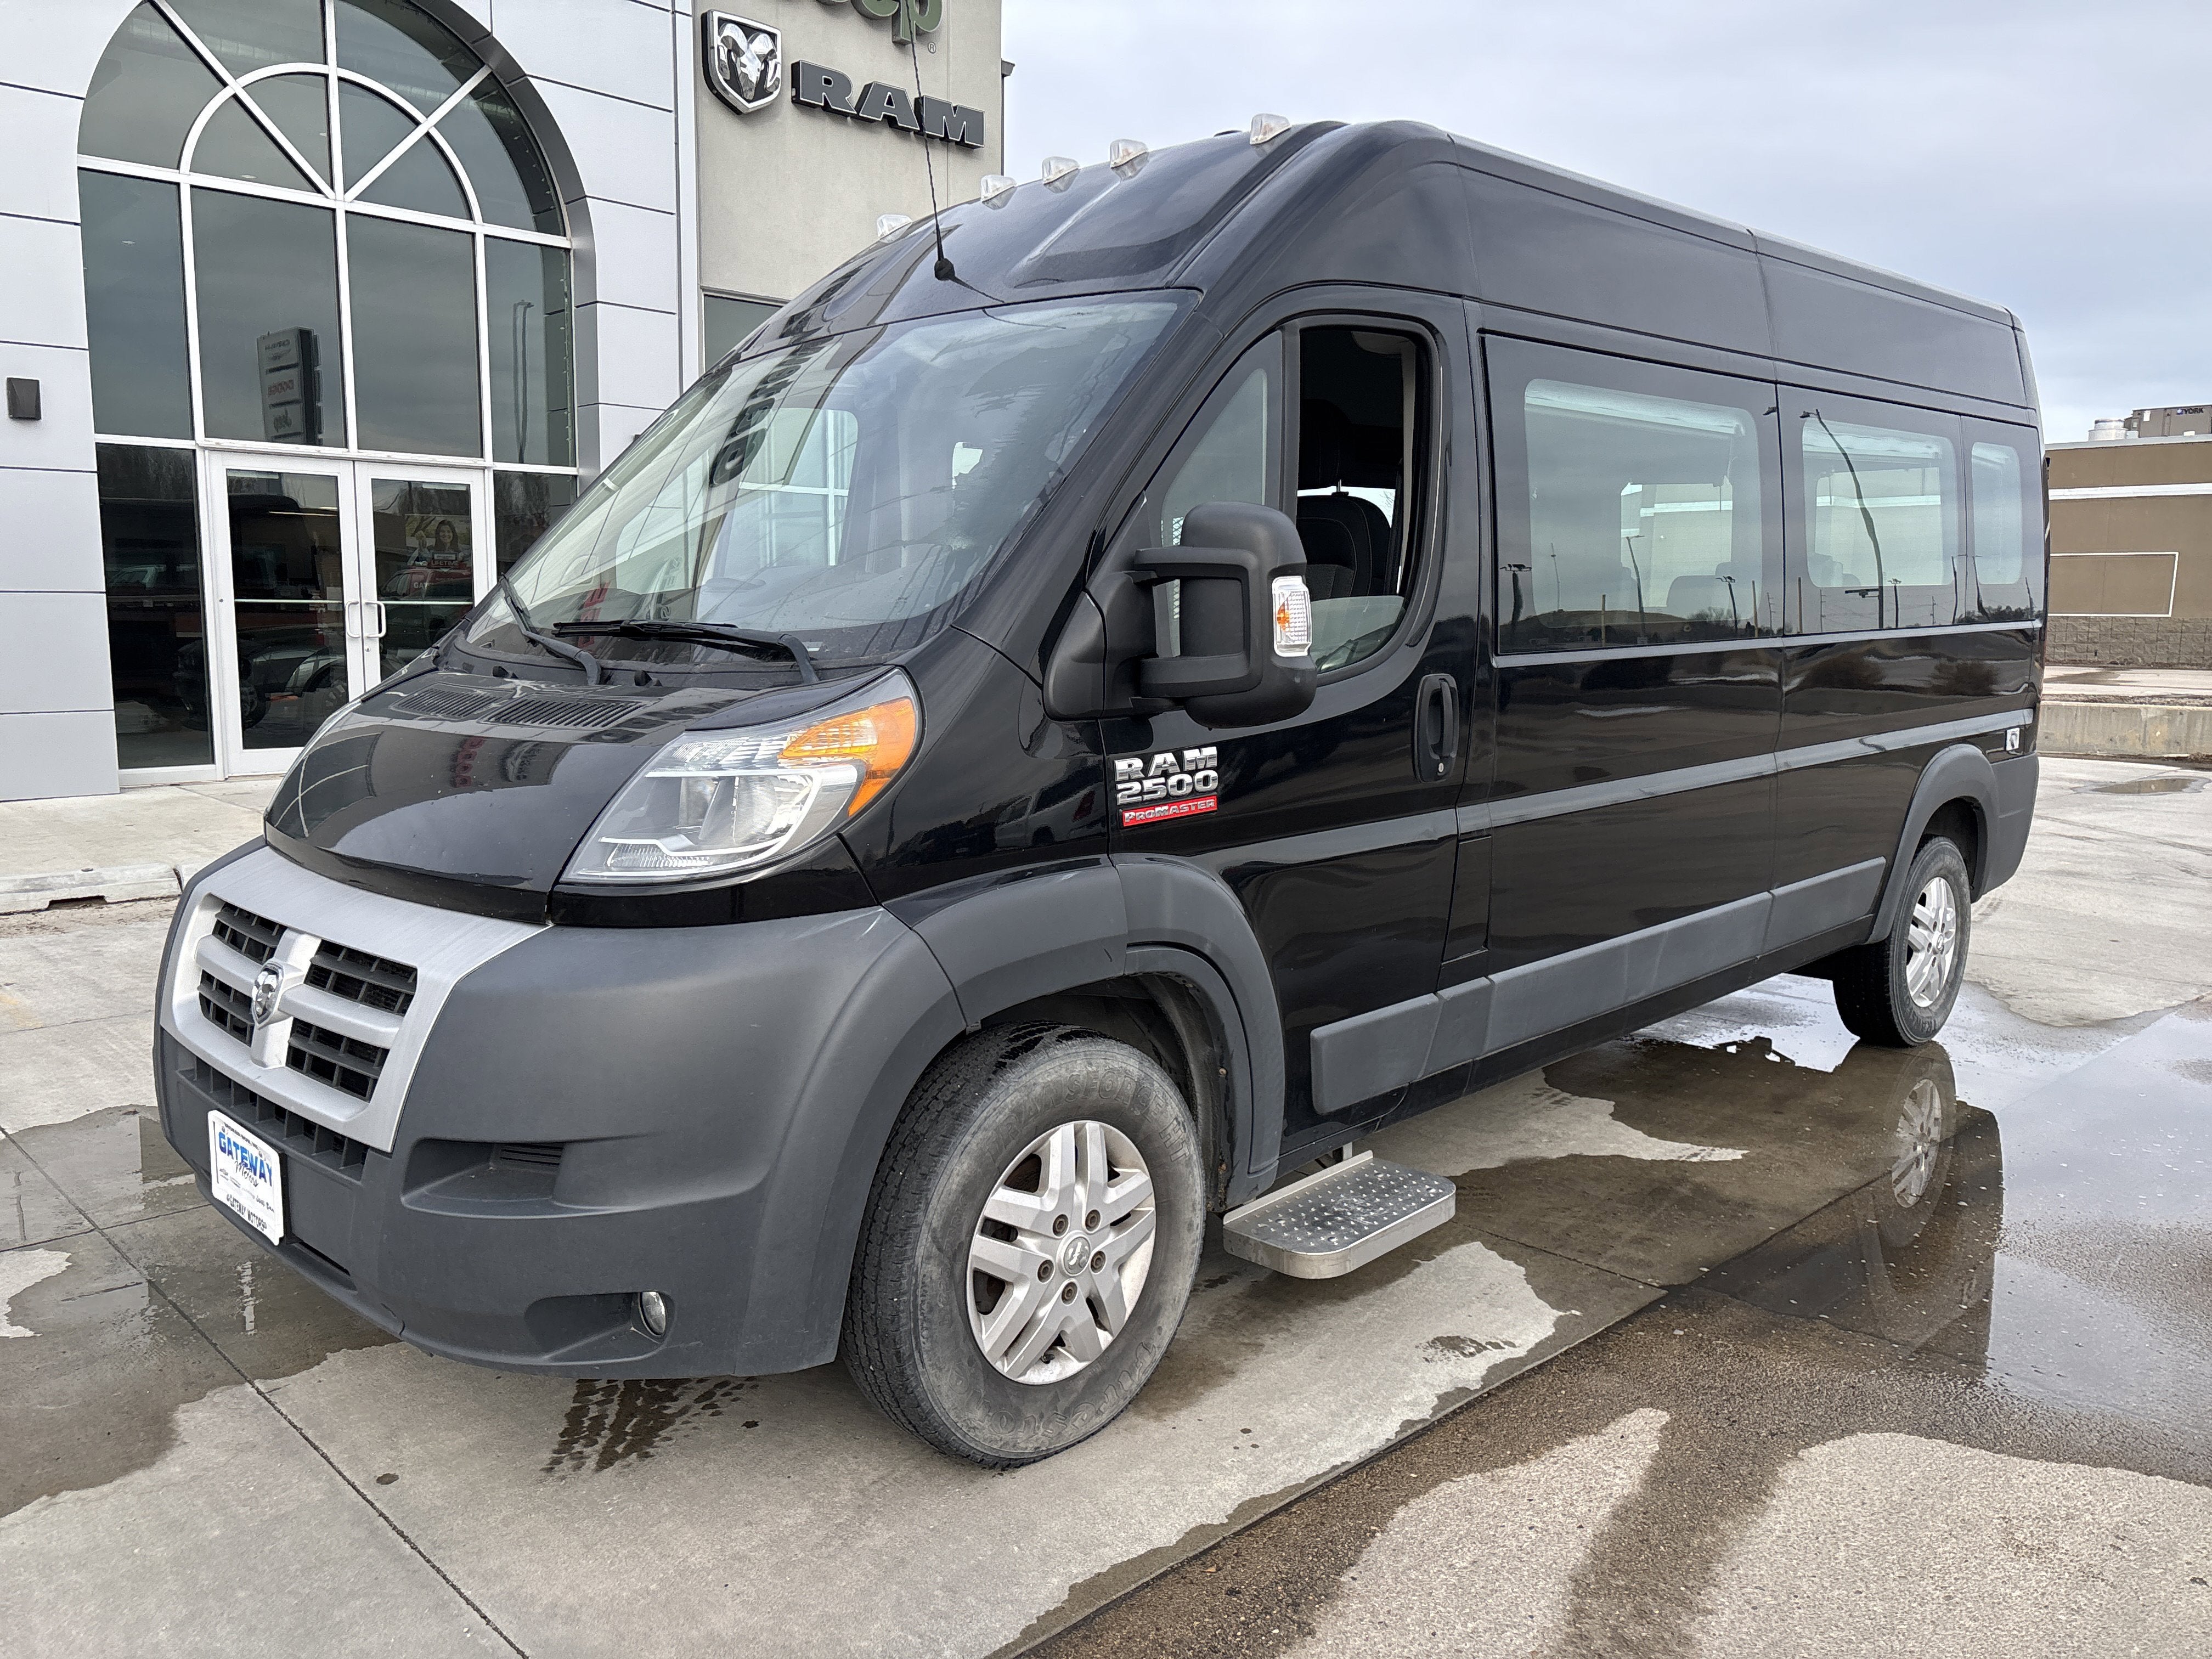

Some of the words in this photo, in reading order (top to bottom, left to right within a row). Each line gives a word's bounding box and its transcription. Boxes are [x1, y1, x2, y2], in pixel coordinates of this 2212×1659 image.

[792, 60, 985, 149] RAM
[1114, 746, 1217, 782] RAM
[1116, 769, 1218, 806] 2500
[218, 1131, 272, 1187] GATEWAY
